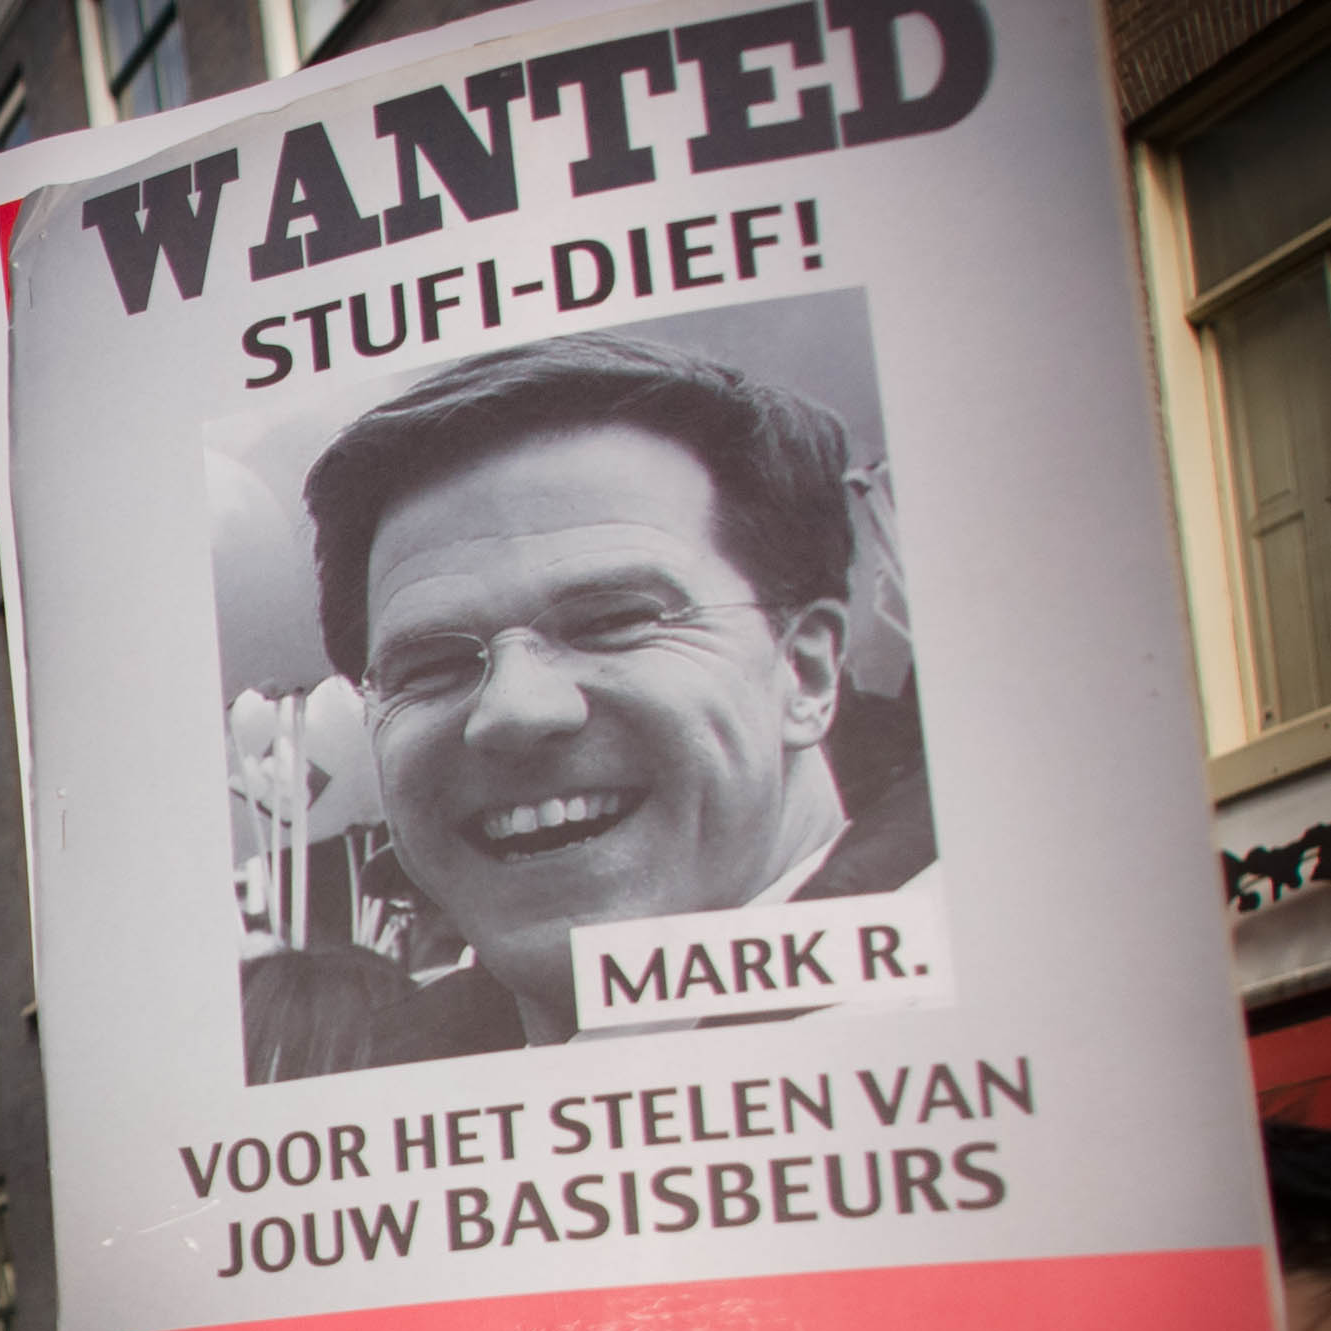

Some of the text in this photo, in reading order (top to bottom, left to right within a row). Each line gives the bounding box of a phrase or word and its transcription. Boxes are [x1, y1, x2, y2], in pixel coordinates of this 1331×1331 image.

[83, 0, 995, 314] WANTED
[243, 197, 824, 389] STUFI-DIEF!
[599, 924, 930, 1007] MARK R.
[179, 1056, 1036, 1199] VOOR HET STELEN VAN
[217, 1141, 1007, 1279] JOUW BASISBEURS
